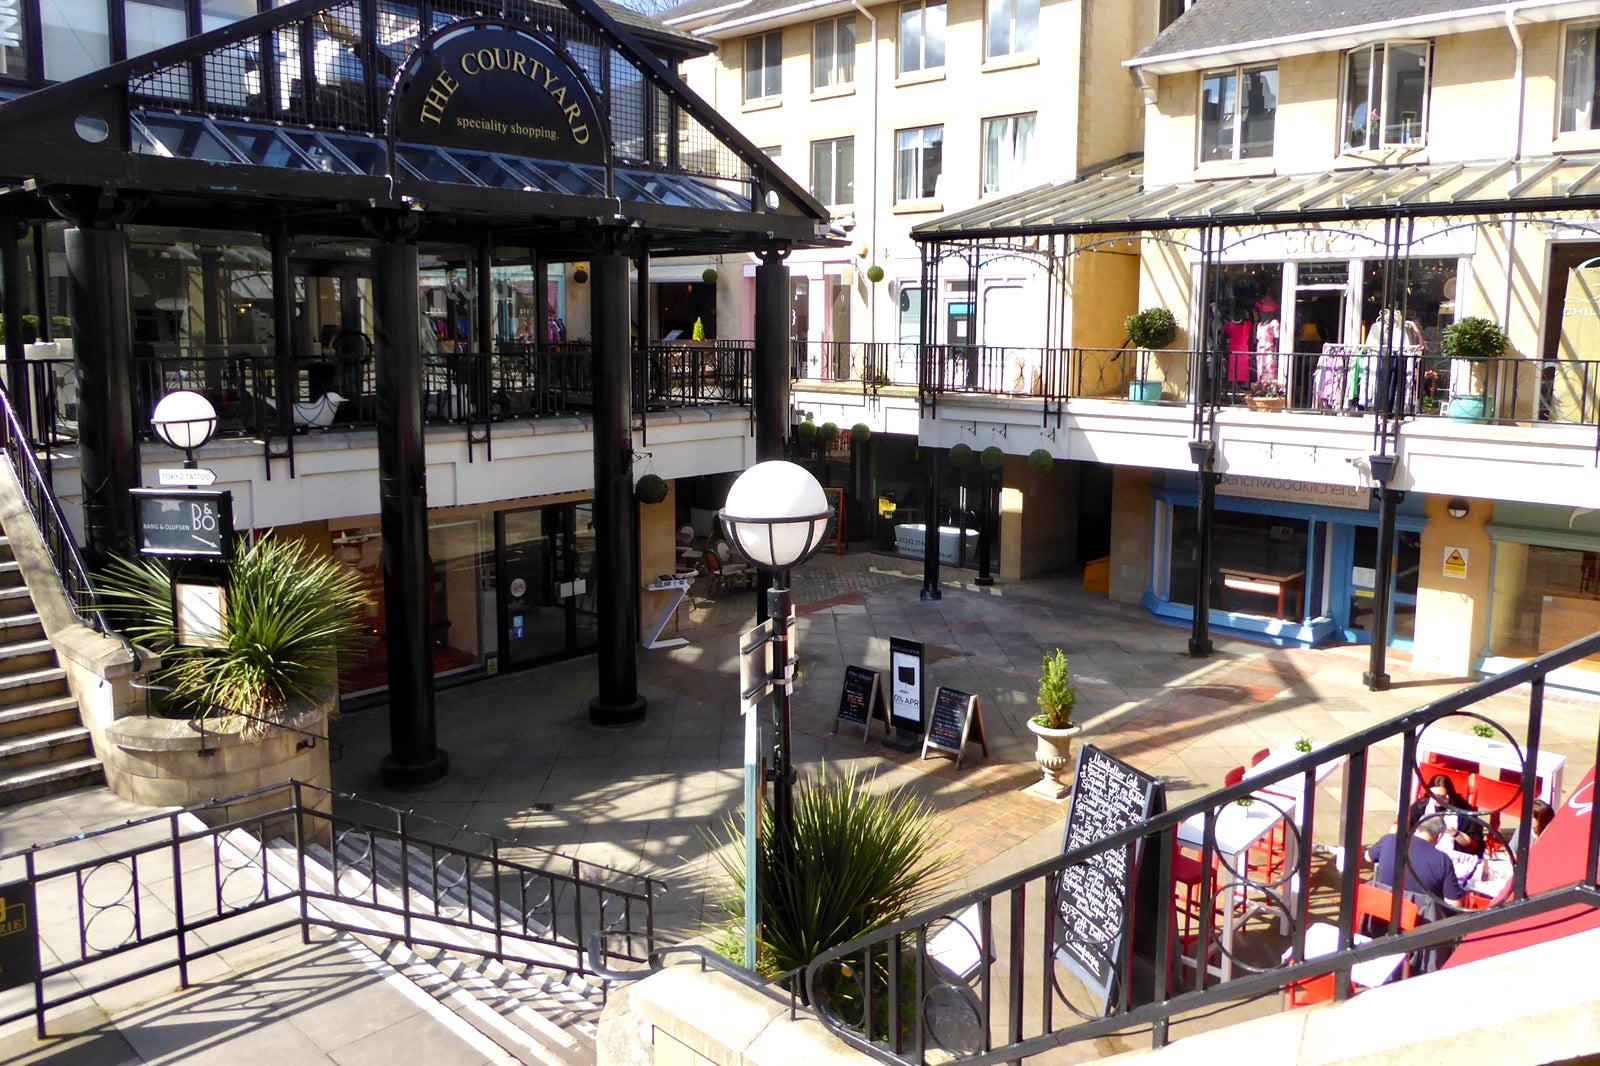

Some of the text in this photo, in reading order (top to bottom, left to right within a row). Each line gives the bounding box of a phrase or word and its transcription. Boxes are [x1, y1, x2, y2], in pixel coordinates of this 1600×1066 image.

[420, 48, 590, 145] THE COURTYARD
[456, 116, 508, 134] speciality
[162, 473, 211, 481] TOKYO TATTOO
[904, 697, 919, 706] APR
